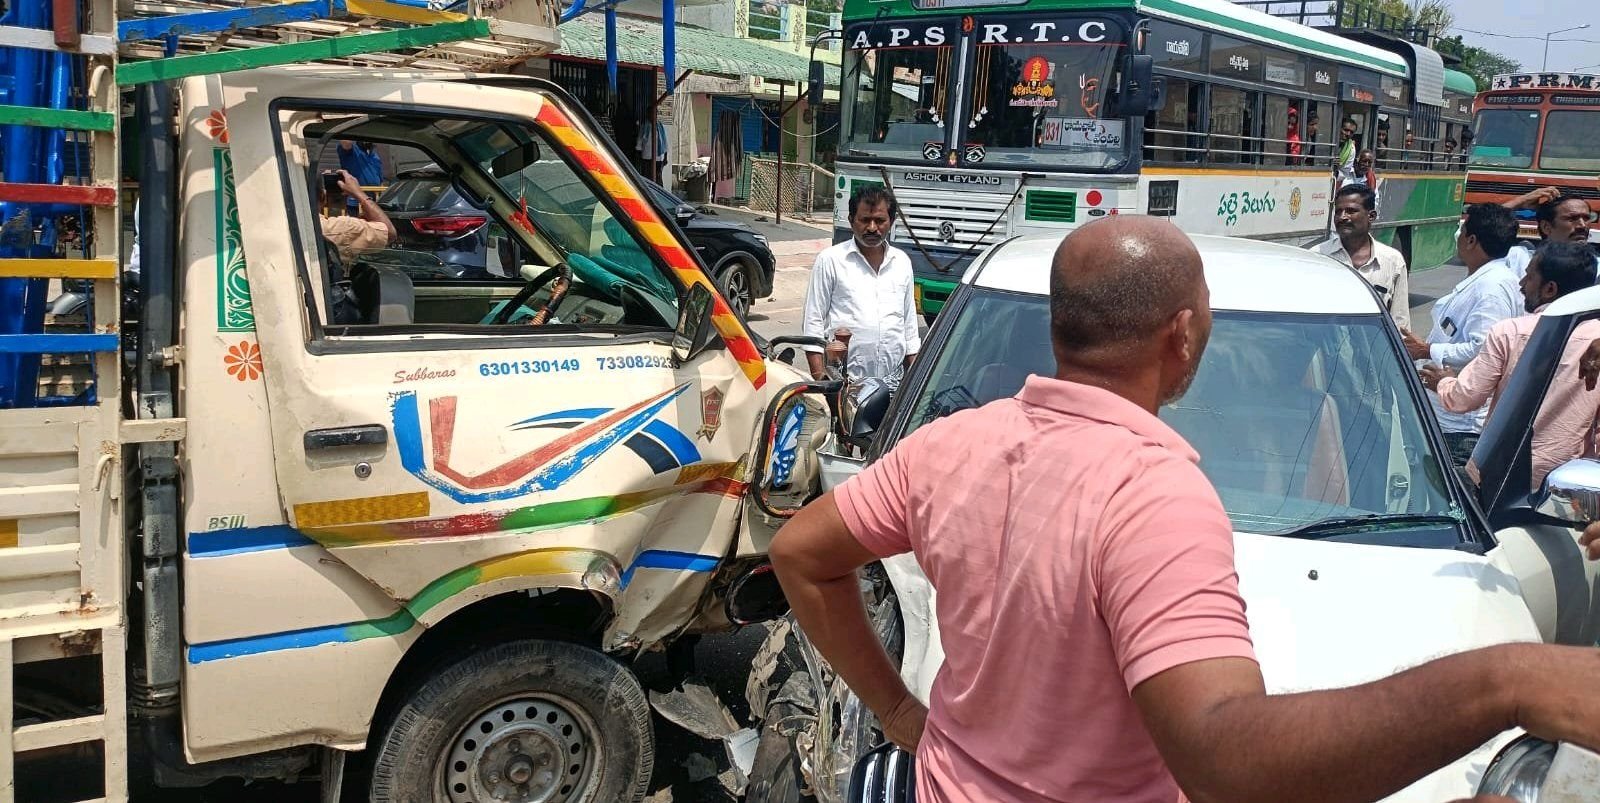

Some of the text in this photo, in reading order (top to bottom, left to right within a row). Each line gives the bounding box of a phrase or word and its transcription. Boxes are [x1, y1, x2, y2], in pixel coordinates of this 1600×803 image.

[1045, 122, 1060, 141] 831
[905, 172, 1000, 185] ASHOK LEYLAND
[479, 358, 580, 377] 6301330149
